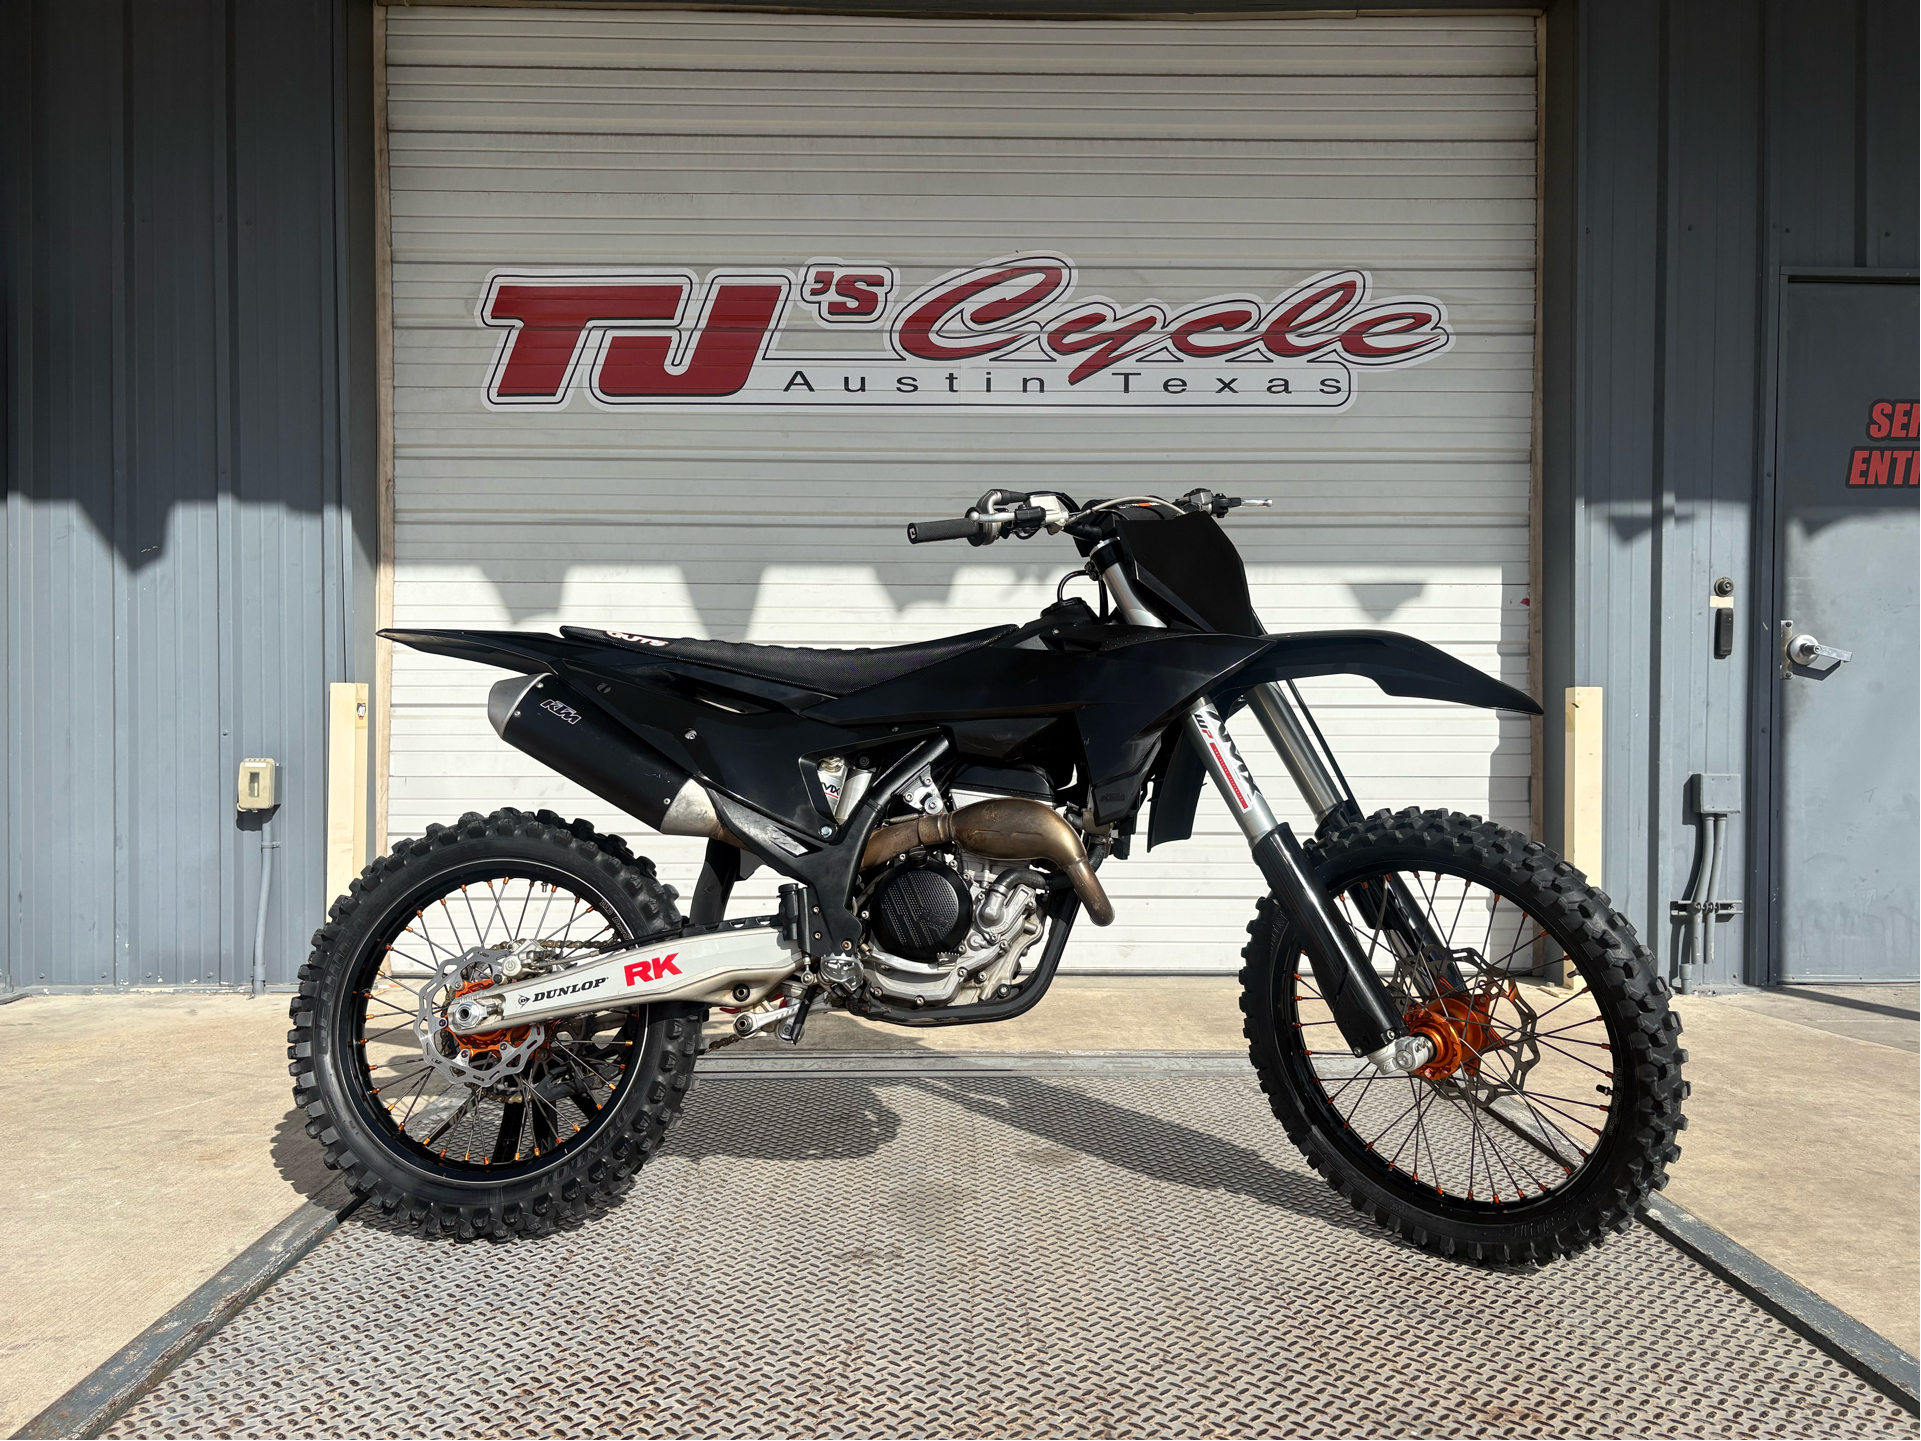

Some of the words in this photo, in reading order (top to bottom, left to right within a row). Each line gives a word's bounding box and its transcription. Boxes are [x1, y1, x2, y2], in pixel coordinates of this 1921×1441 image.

[899, 266, 1441, 386] Cycle
[783, 370, 1046, 394] Austin
[1112, 371, 1343, 394] Texas
[605, 630, 668, 647] GUTS
[540, 699, 582, 725] KTM
[624, 953, 683, 987] RK
[532, 977, 606, 1003] DUNLOP
